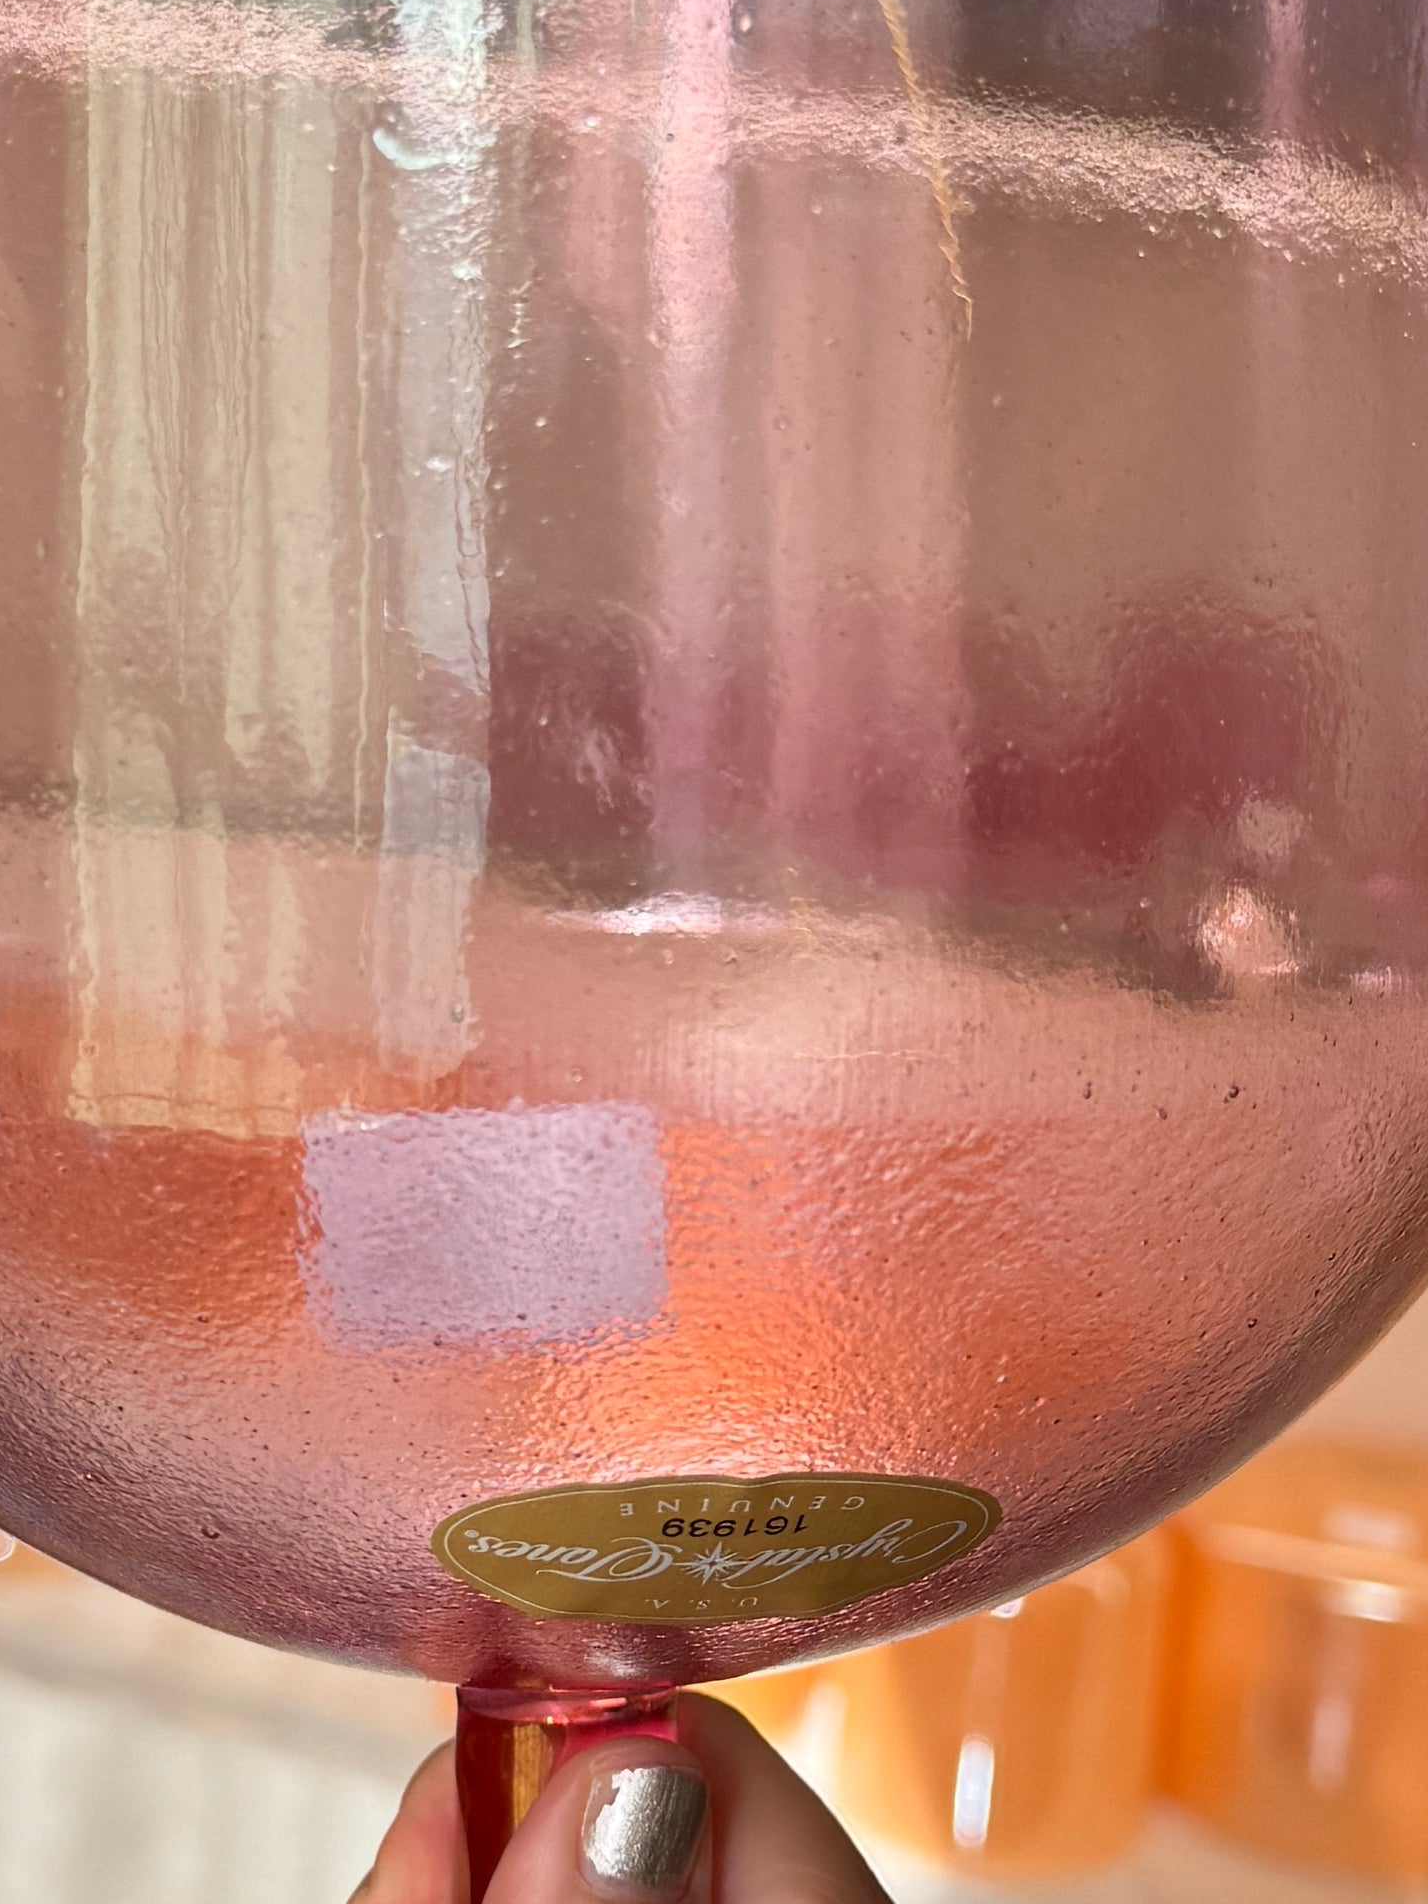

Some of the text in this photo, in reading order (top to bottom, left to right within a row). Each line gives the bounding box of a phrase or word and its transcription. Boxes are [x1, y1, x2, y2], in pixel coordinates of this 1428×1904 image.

[619, 1496, 865, 1516] GENUINE
[662, 1515, 808, 1538] 161939
[722, 1518, 967, 1589] Crystal
